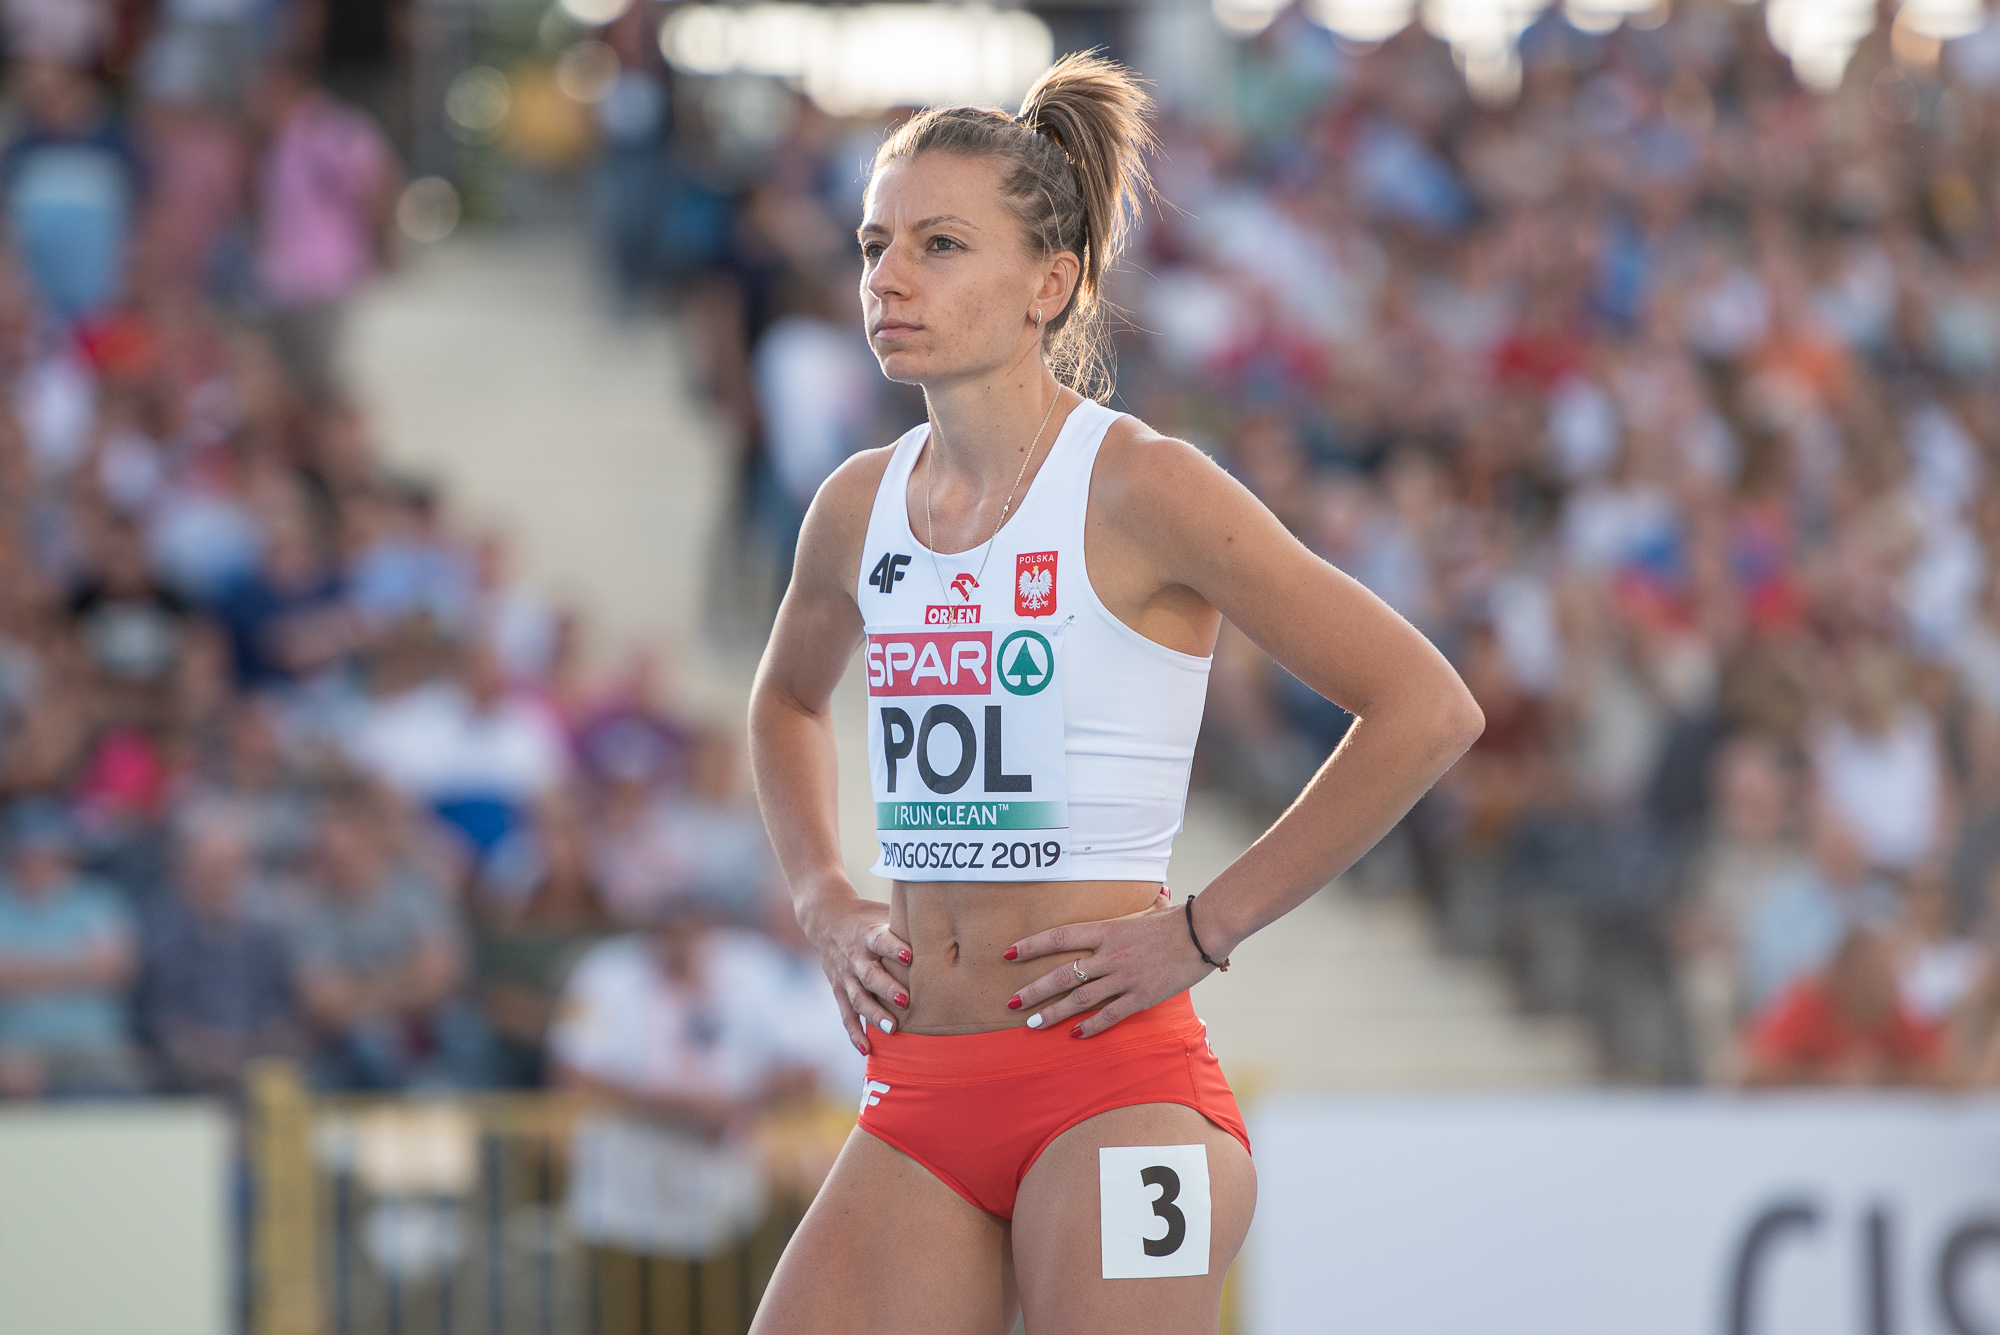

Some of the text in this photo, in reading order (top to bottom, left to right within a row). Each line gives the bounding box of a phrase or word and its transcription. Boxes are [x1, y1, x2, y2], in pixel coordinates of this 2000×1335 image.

[869, 552, 912, 594] 4F
[1019, 554, 1055, 564] POLSKA
[927, 608, 977, 624] ORLEN
[867, 640, 987, 687] SPAR
[880, 703, 1032, 795] POL
[894, 805, 898, 825] I
[900, 805, 932, 825] RUN
[882, 841, 1061, 869] BYDGOSZCZ 2019
[1140, 1165, 1186, 1257] 3
